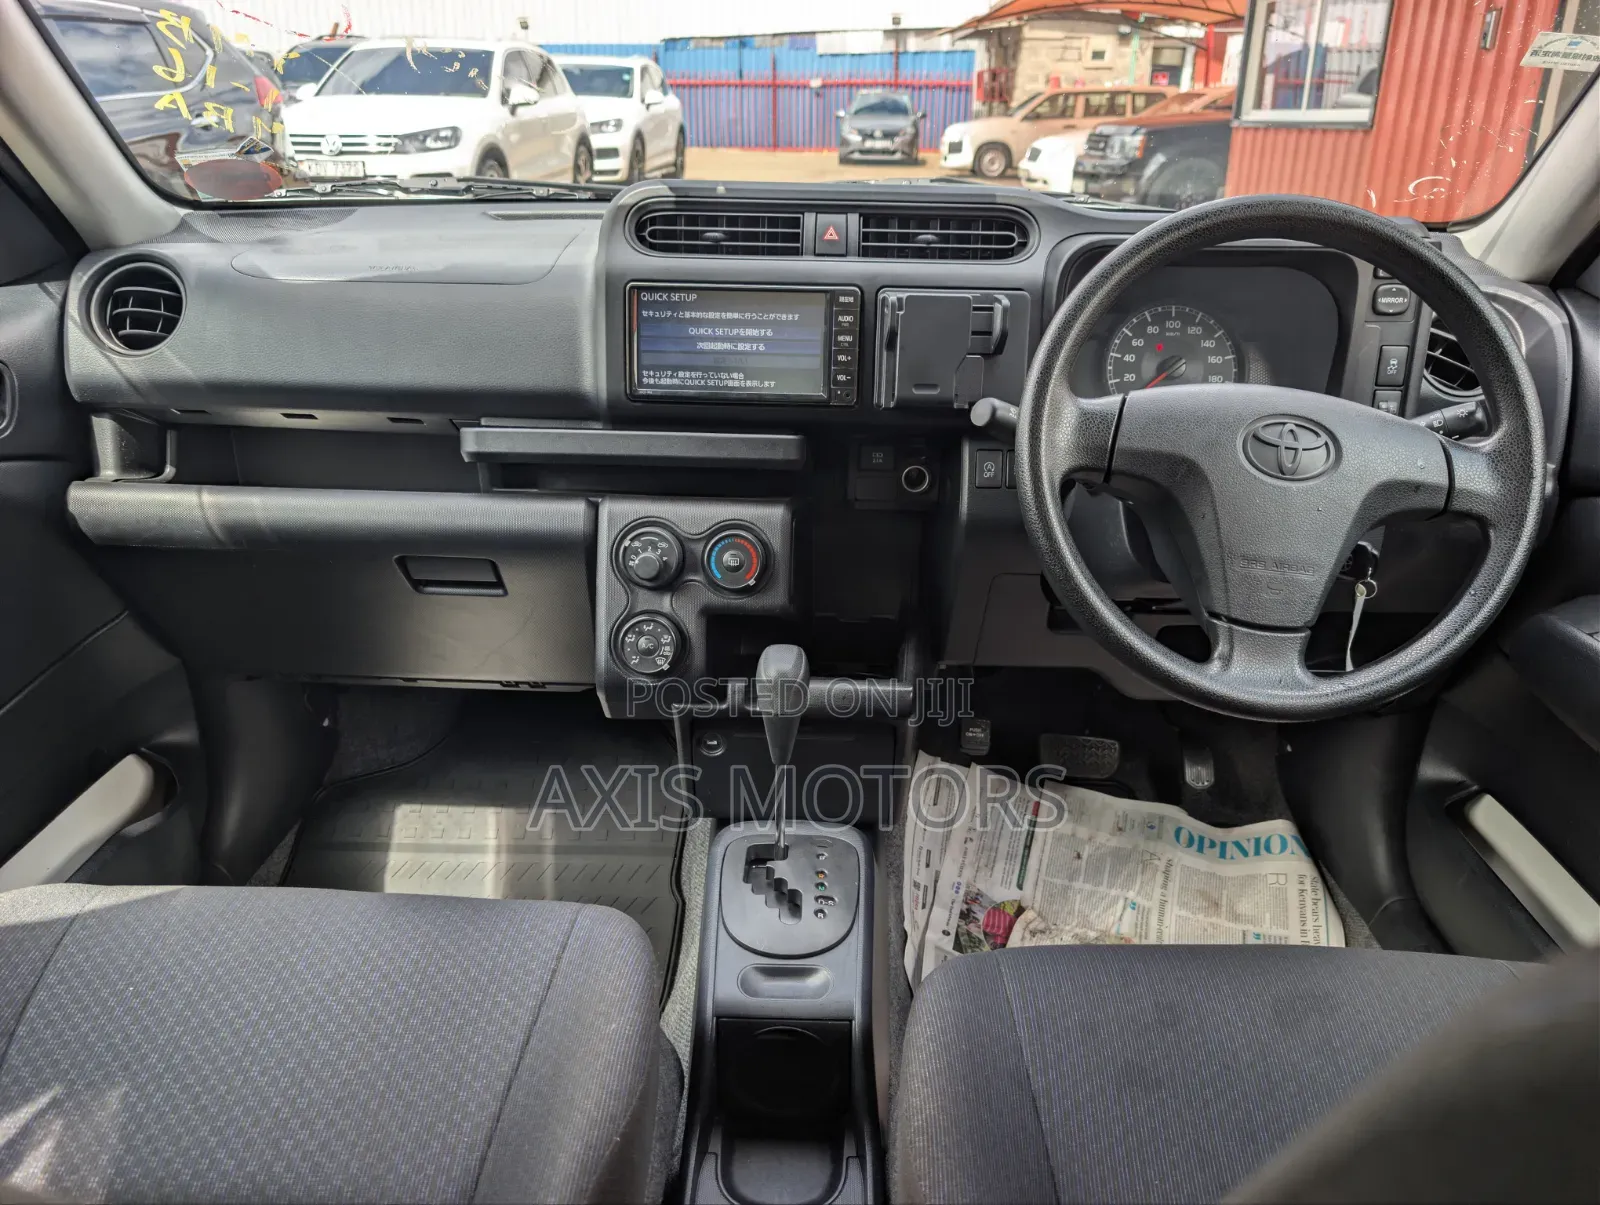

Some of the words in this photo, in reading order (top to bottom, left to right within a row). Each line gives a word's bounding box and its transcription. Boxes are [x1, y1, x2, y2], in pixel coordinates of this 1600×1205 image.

[640, 292, 668, 301] QUICK
[670, 293, 697, 301] SETUP
[1166, 320, 1181, 328] 100
[715, 328, 773, 336] SETUPを開始する
[1188, 326, 1202, 334] 120
[696, 342, 765, 351] 次回起動時に設定する
[1201, 339, 1216, 348] 140
[1208, 356, 1223, 364] 160
[1160, 858, 1174, 890] shaping
[1297, 874, 1308, 886] for
[1310, 876, 1320, 896] State
[1297, 889, 1308, 927] Kenyans
[1311, 898, 1322, 922] bears
[1300, 928, 1311, 937] in
